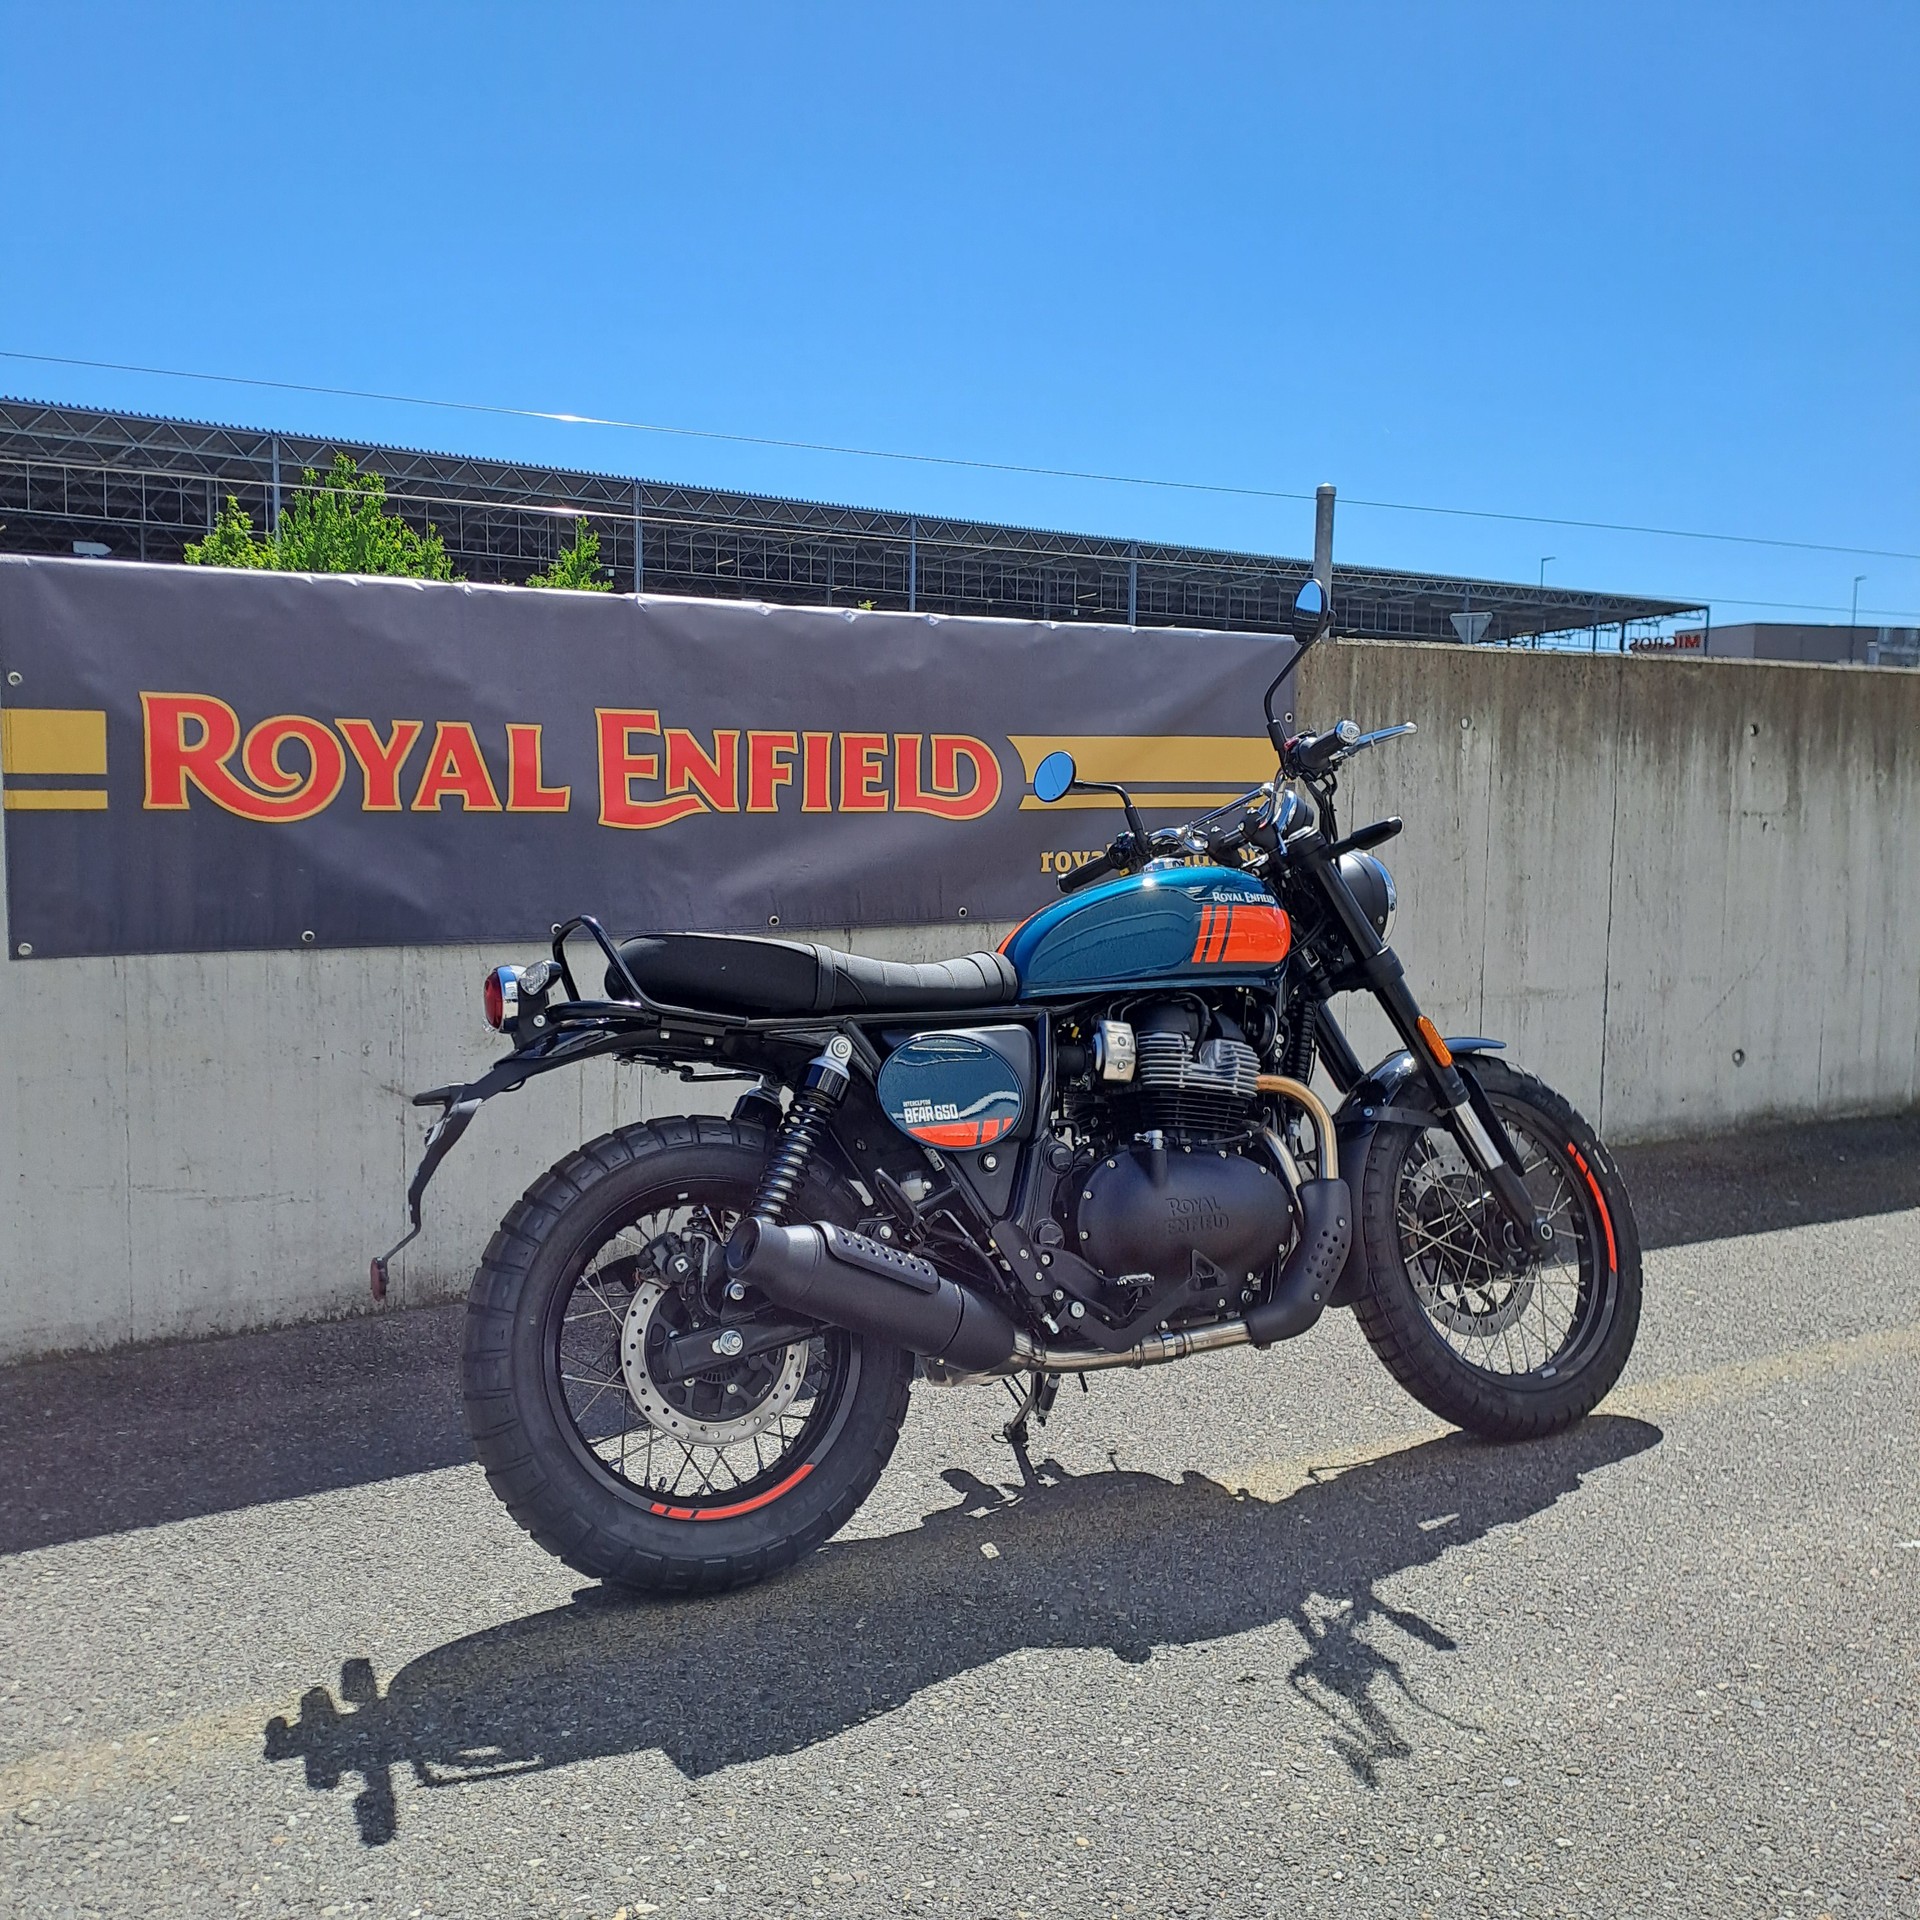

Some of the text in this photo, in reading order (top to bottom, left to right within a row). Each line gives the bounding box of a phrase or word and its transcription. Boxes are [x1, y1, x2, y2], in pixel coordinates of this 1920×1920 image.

[139, 691, 1003, 830] ROYAL ENFIELD
[1212, 892, 1275, 904] ROYAL ENFIELD
[904, 1104, 958, 1123] BEAR 650
